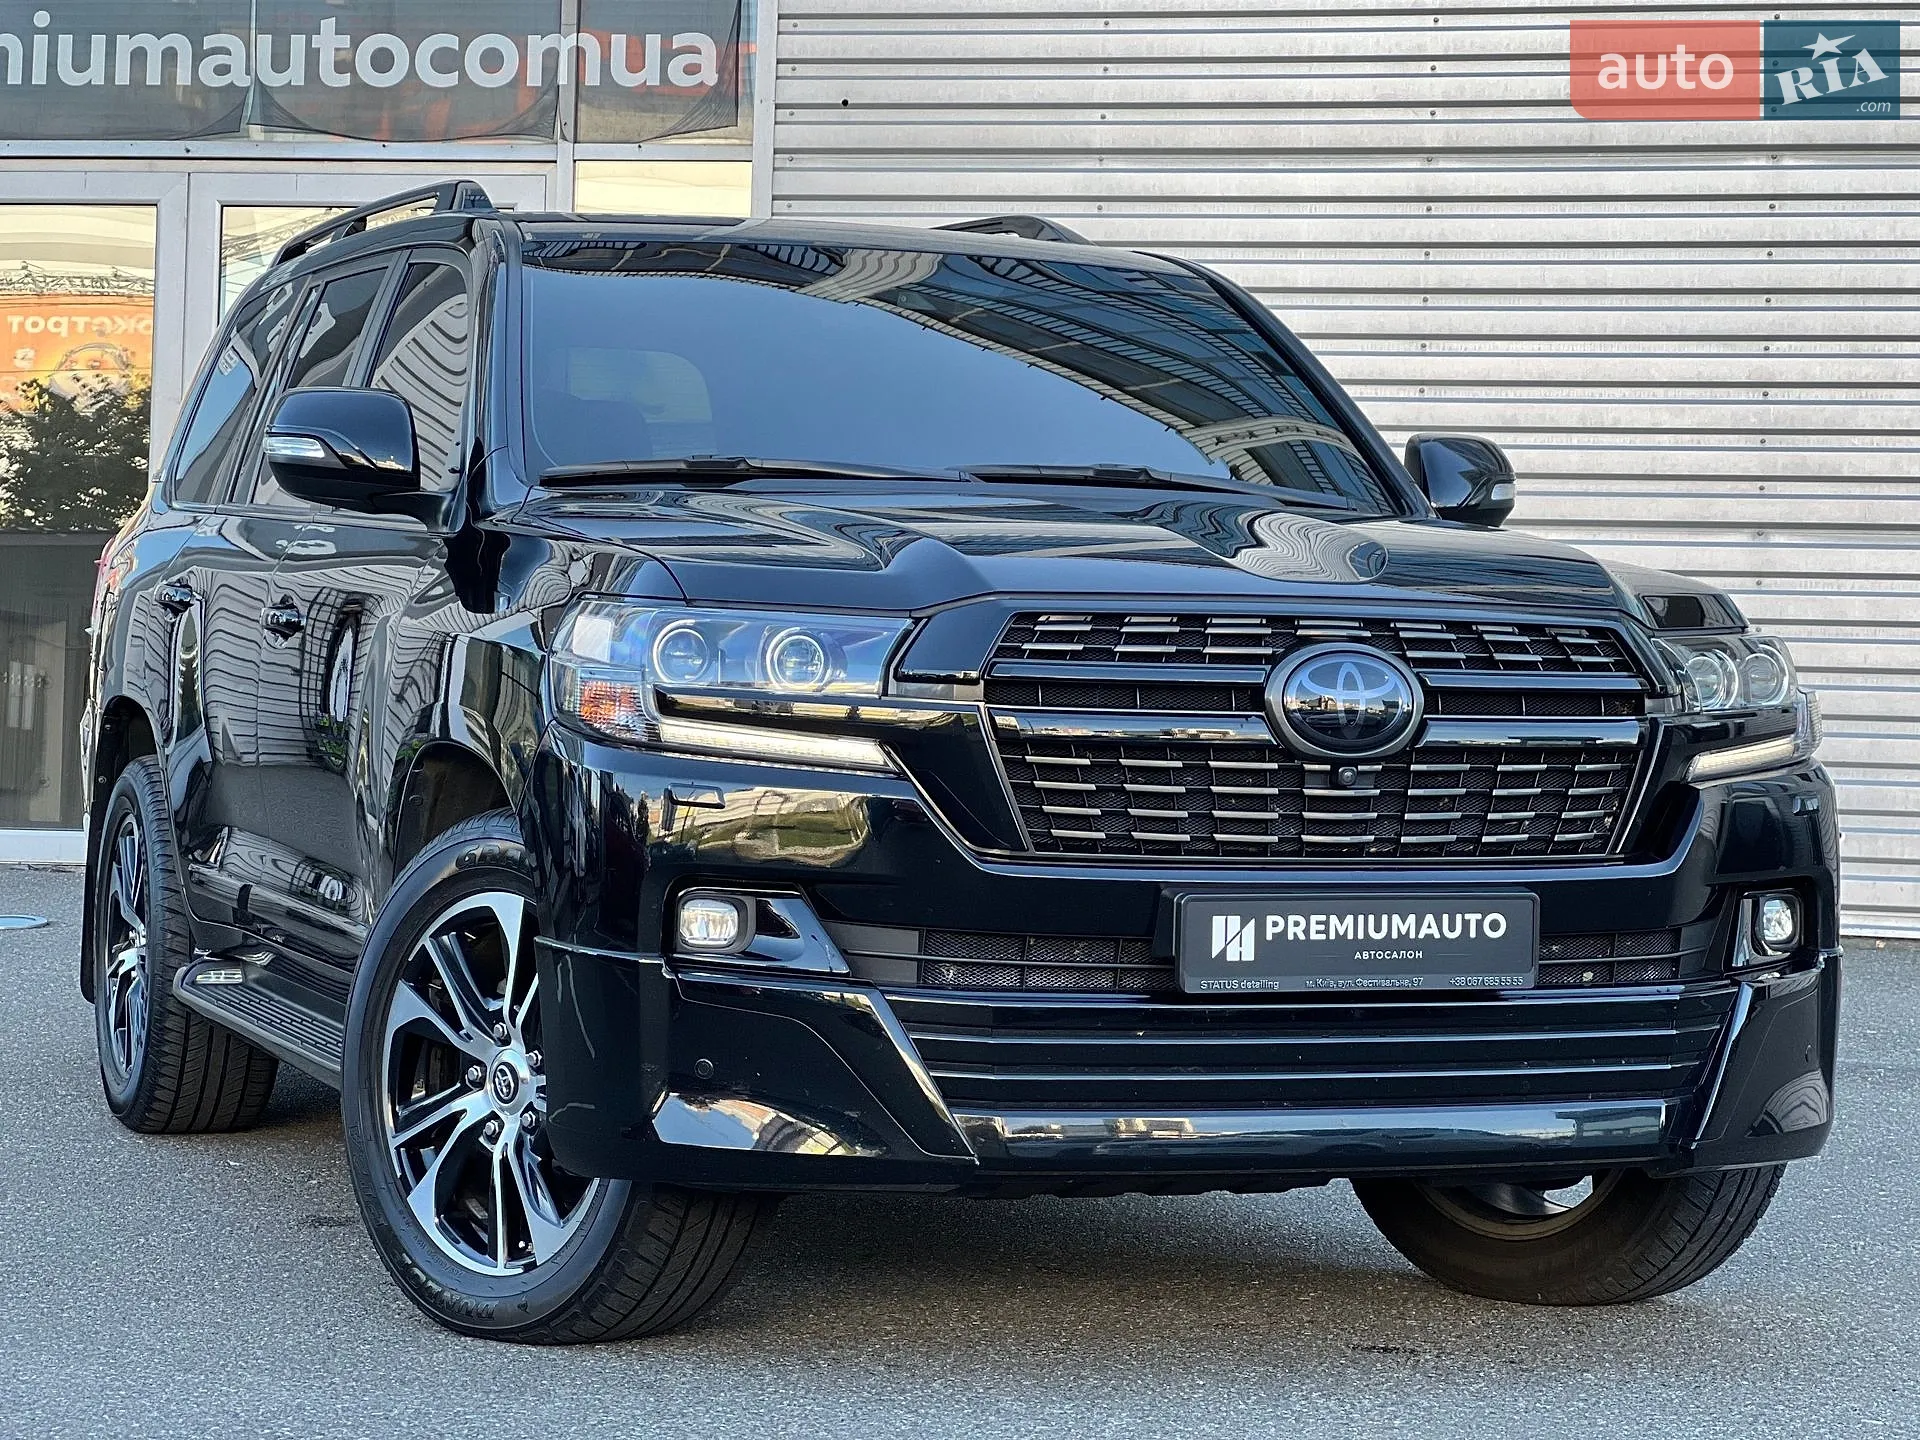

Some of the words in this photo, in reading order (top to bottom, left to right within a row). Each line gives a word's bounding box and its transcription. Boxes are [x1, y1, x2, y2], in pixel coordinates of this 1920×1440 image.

[0, 10, 719, 89] iumautocomua
[1265, 911, 1507, 941] PREMIUMAUTO
[1354, 950, 1423, 960] АВТОСАЛОН
[1200, 979, 1239, 990] STATUS
[1240, 979, 1280, 990] detailing
[1412, 977, 1424, 986] 97
